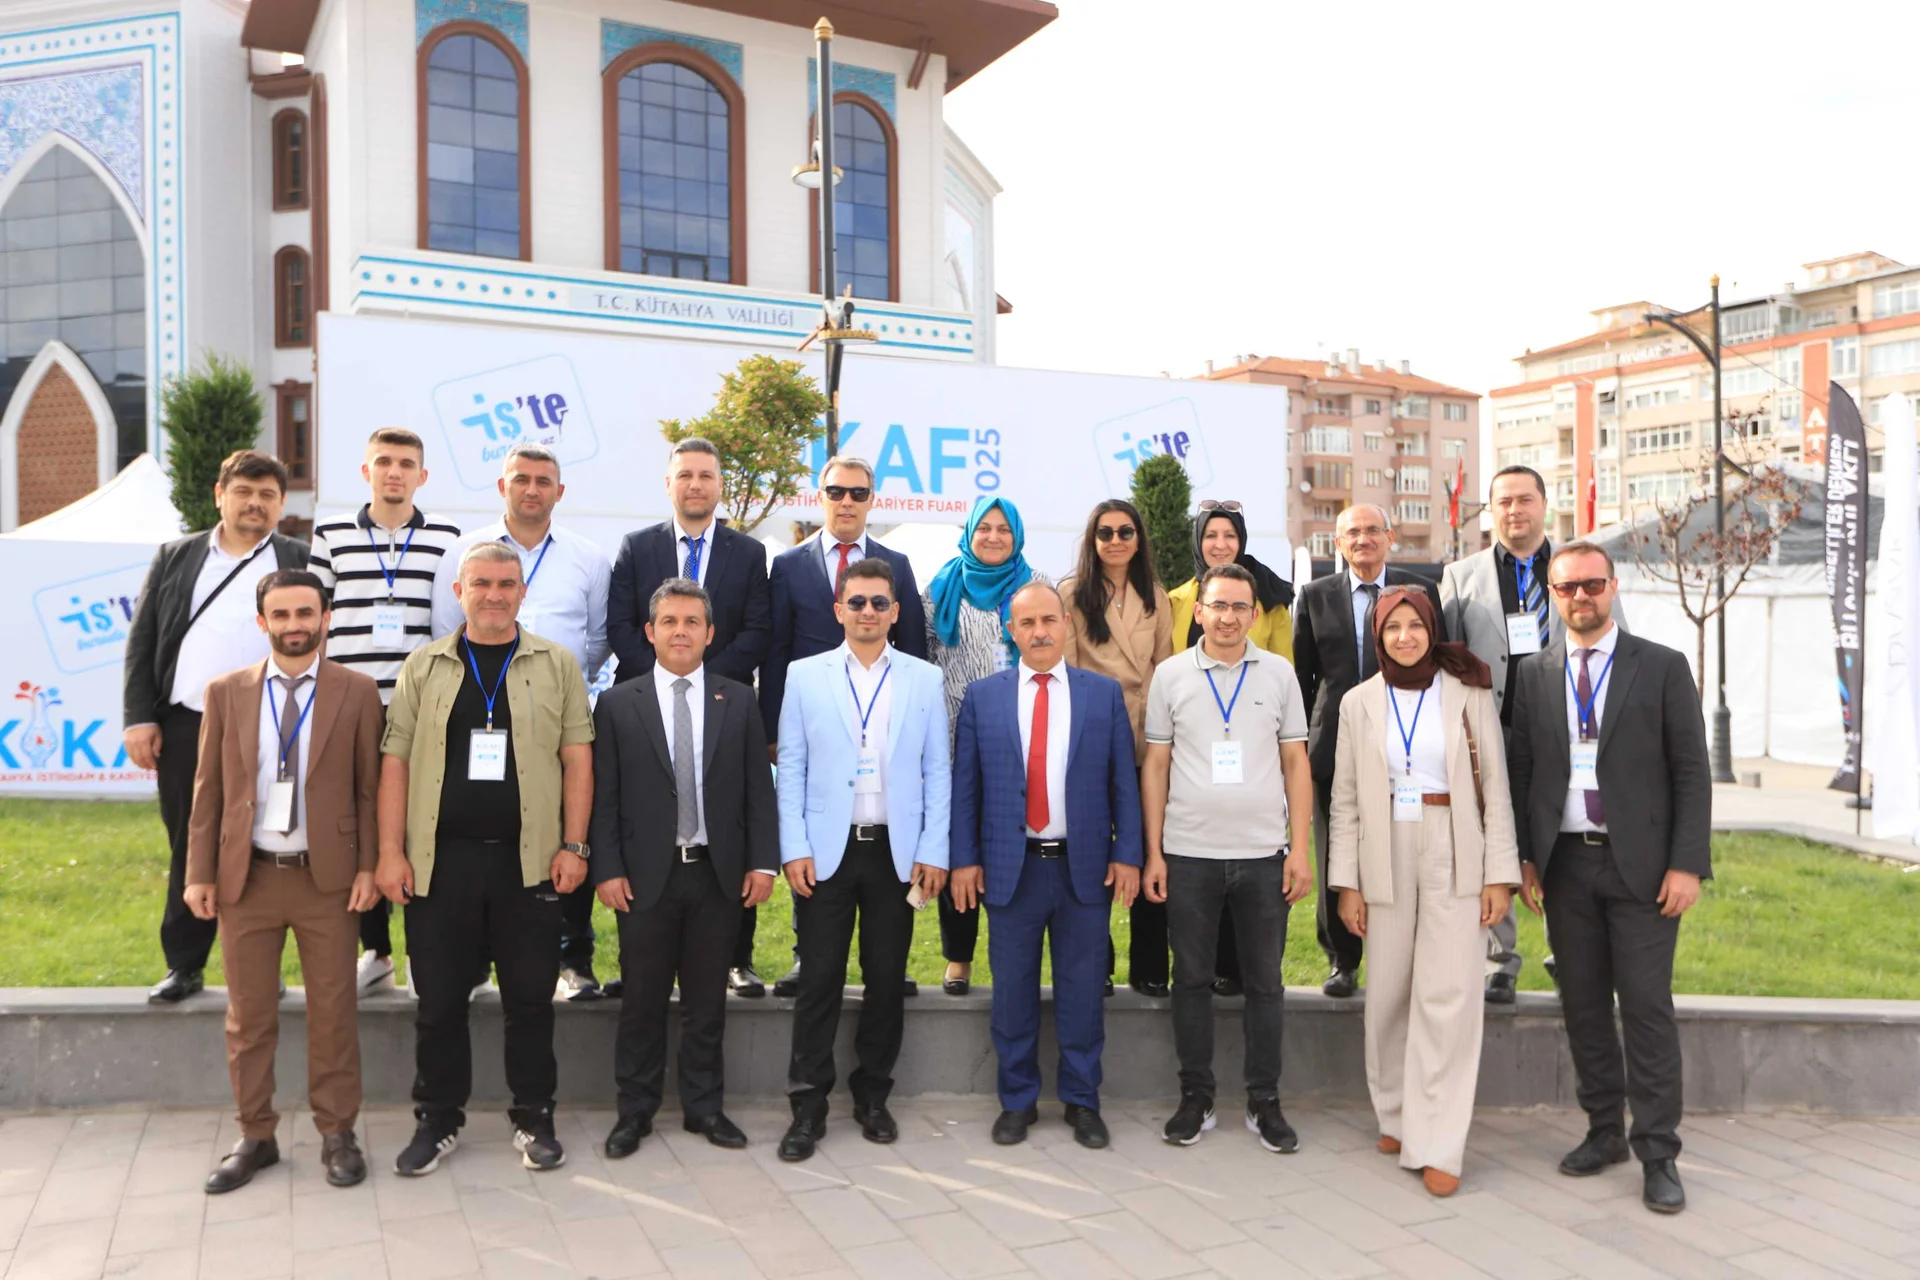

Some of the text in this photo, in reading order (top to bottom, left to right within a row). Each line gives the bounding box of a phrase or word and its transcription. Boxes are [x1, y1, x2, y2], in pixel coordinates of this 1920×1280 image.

[635, 297, 714, 319] KÜTAHYA
[727, 306, 795, 328] VALİLİĞİ
[975, 428, 1001, 505] 025
[873, 497, 924, 511] ARİYER
[928, 500, 967, 513] FUARI
